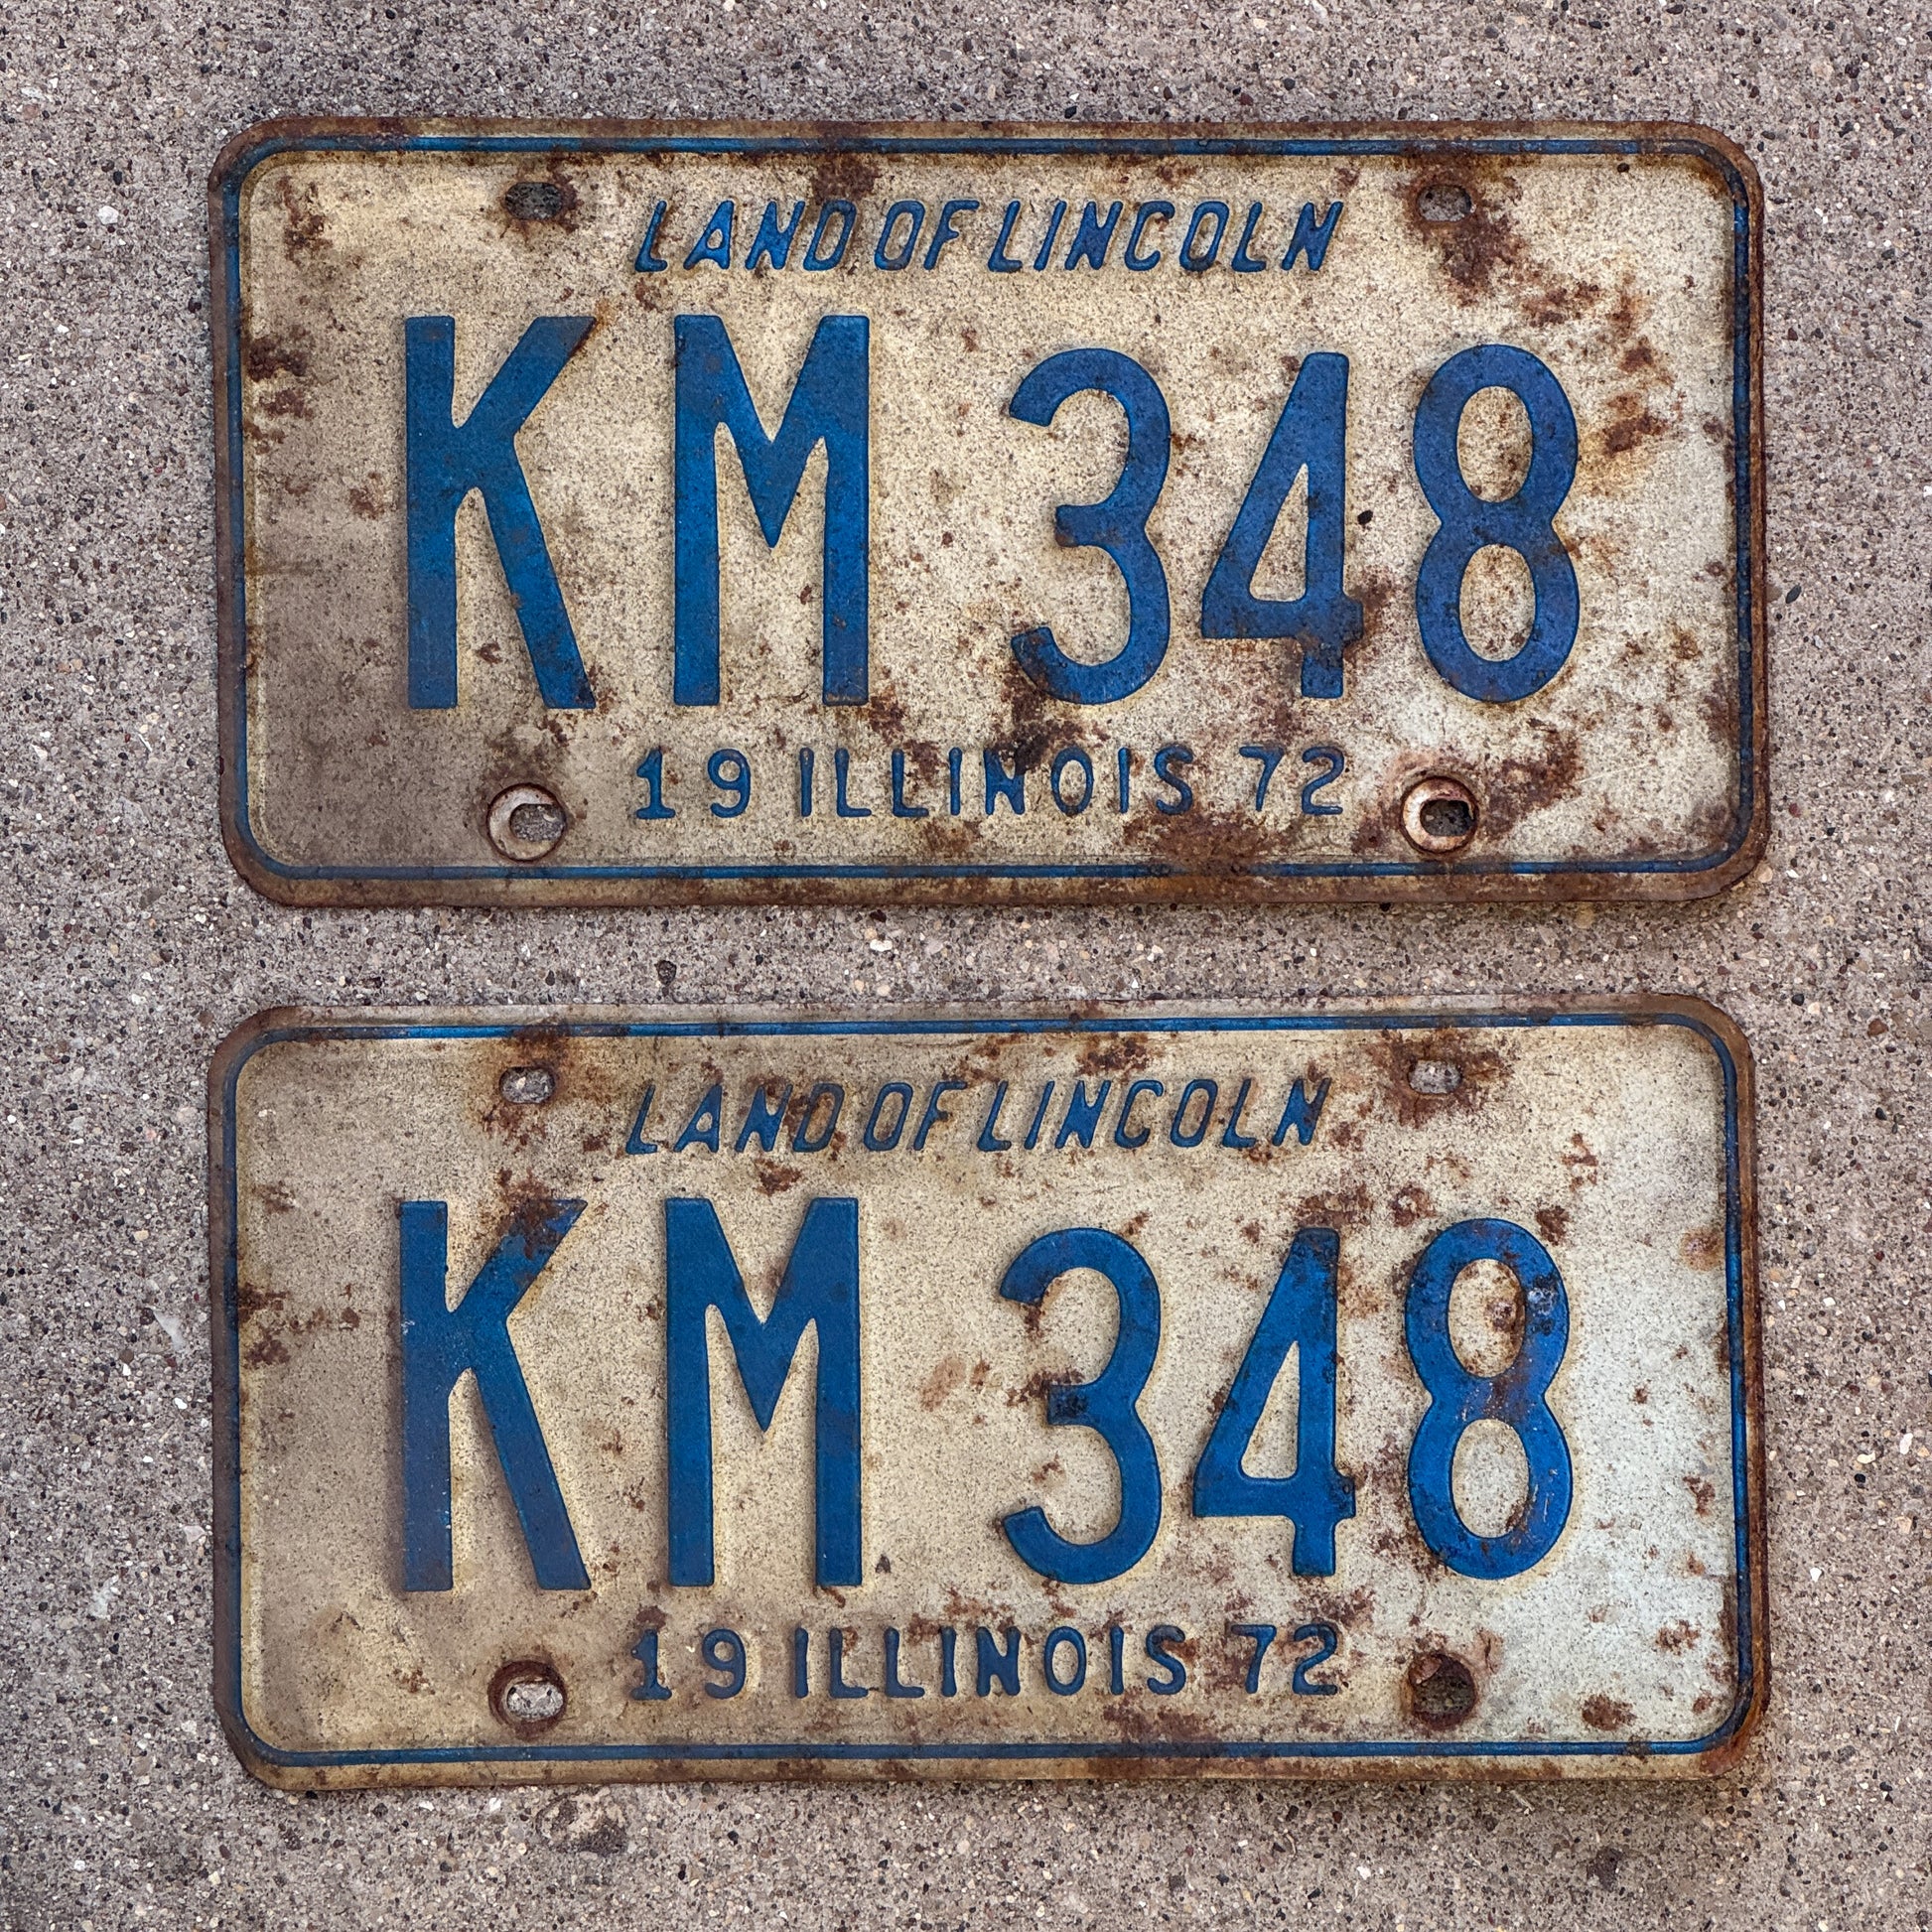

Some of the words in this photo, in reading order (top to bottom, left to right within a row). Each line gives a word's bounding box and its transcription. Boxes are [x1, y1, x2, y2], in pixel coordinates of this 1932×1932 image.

[635, 200, 856, 272] LAND
[873, 200, 979, 270] OF
[988, 200, 1343, 272] LINCOLN
[405, 314, 871, 710] KM
[1009, 343, 1581, 704] 348
[634, 749, 751, 819] 19
[798, 746, 1194, 817] ILLINOIS
[1240, 746, 1344, 815] 72
[627, 1083, 843, 1153] LAND
[863, 1081, 965, 1150] OF
[977, 1079, 1329, 1151] LINCOLN
[397, 1195, 861, 1590] KM
[998, 1218, 1573, 1584] 348
[631, 1628, 746, 1699] 19
[795, 1626, 1187, 1697] ILLINOIS
[1234, 1623, 1337, 1694] 72
